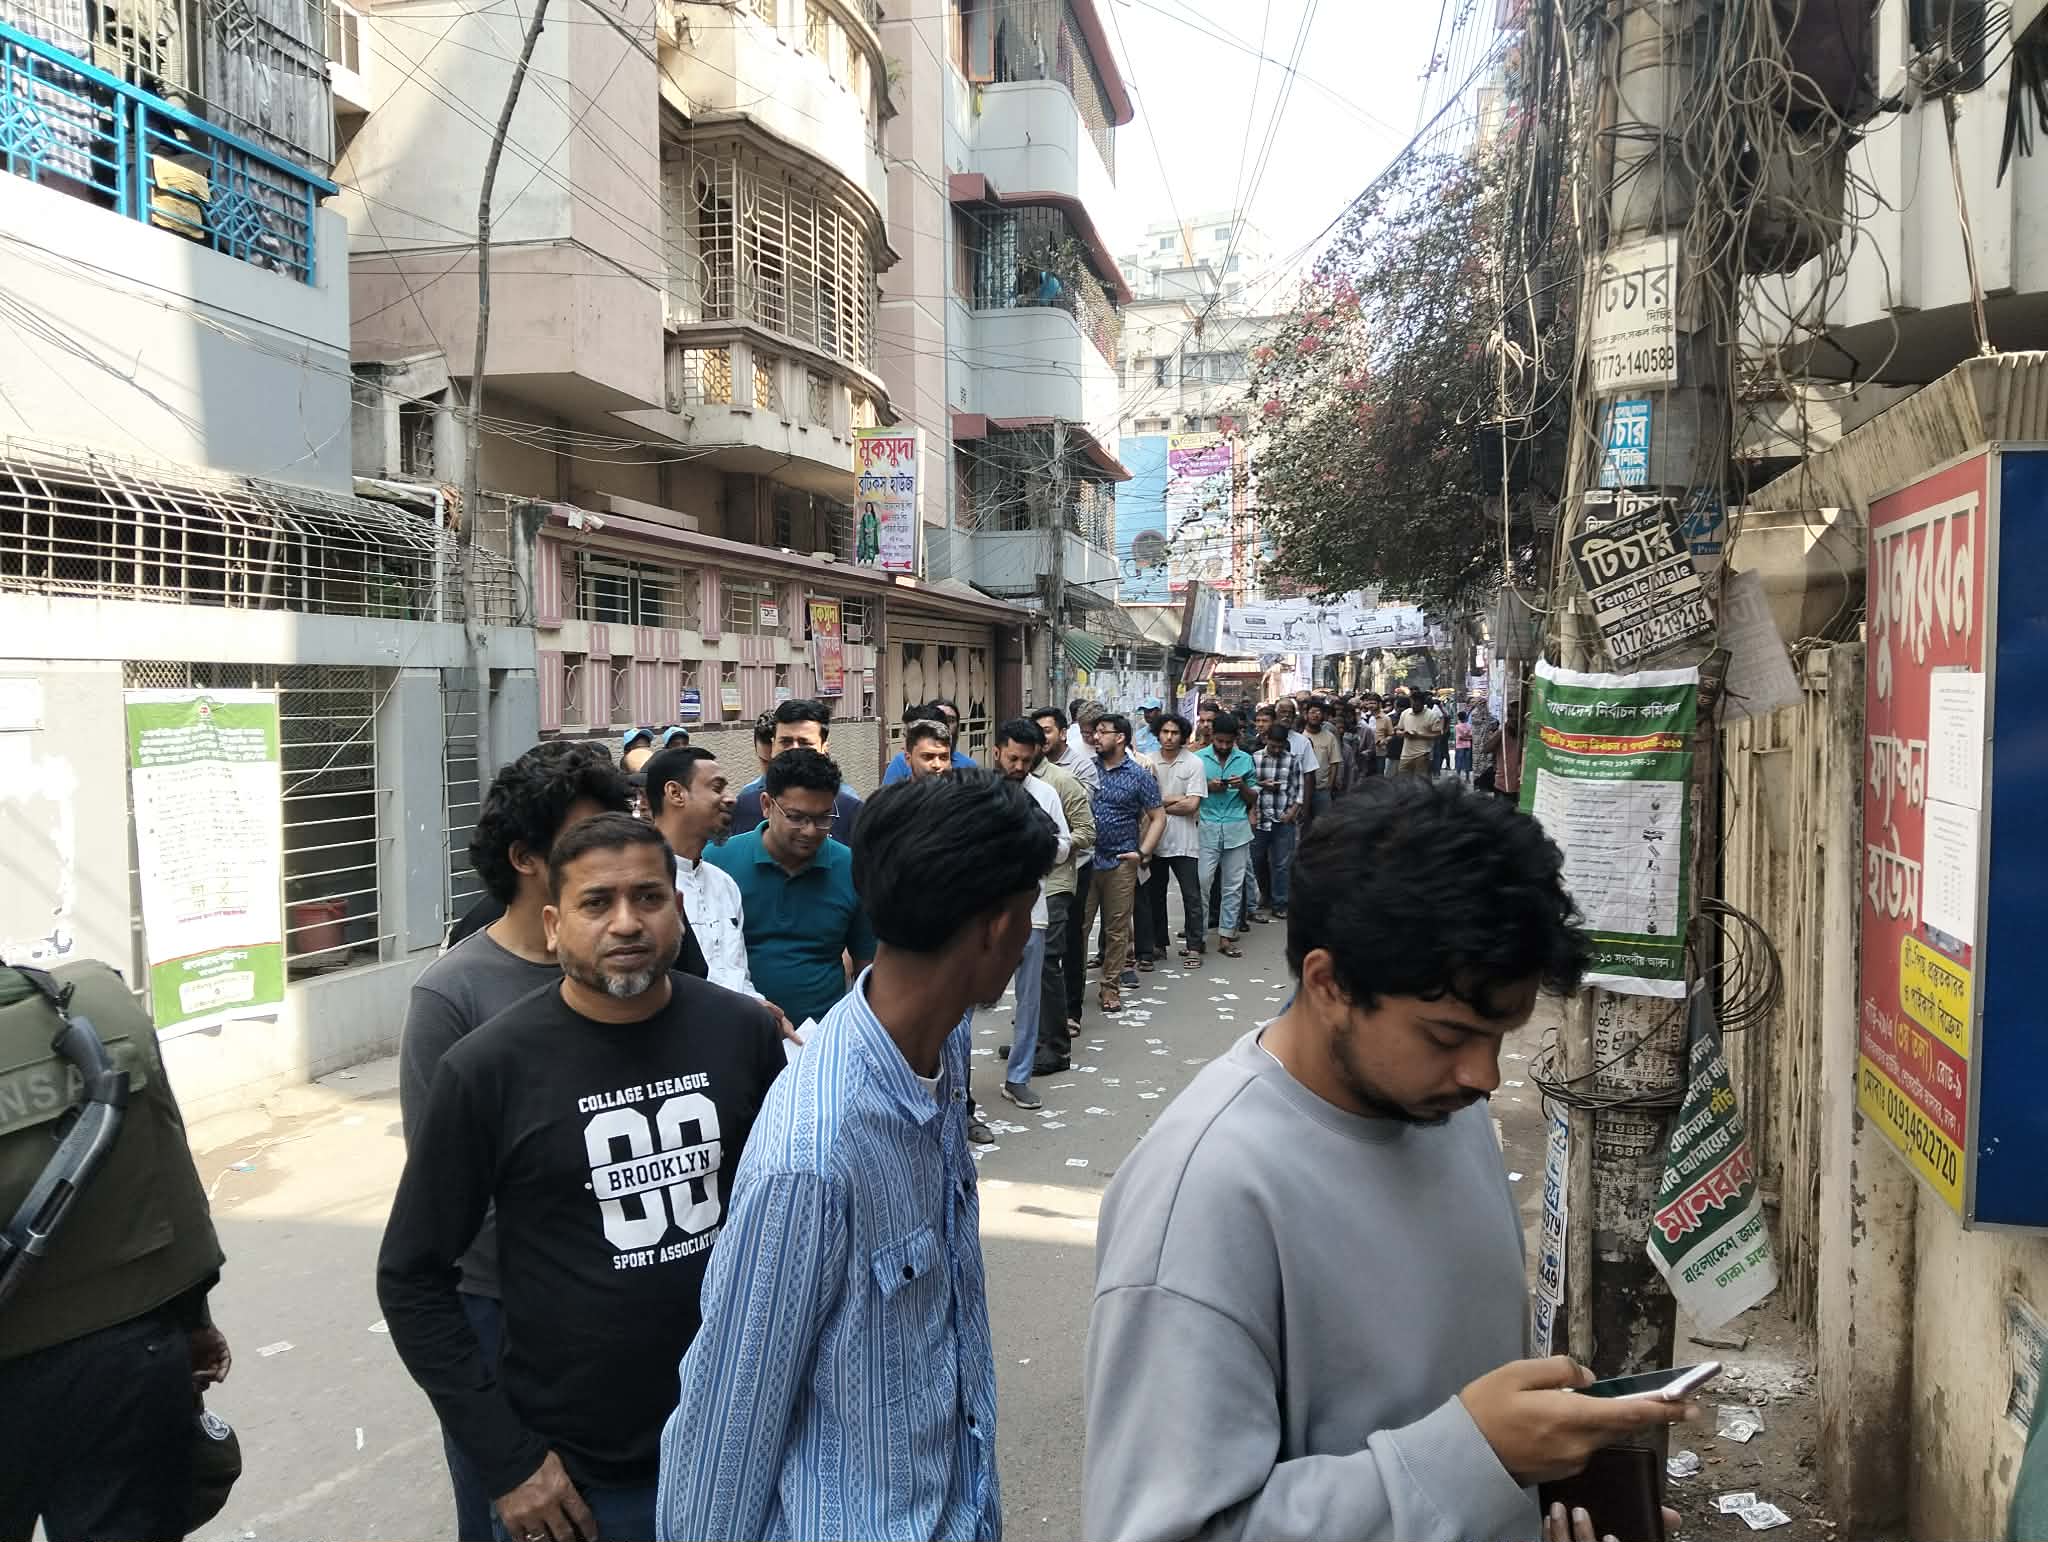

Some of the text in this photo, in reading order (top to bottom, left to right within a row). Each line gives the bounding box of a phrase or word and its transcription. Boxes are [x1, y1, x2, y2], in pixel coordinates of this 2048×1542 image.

[1870, 733, 1926, 830] ফ্যাশন
[578, 1072, 710, 1113] COLLAGE LEEAGUE
[1887, 1086, 1956, 1189] 01914622720
[608, 1150, 710, 1191] BROOKLYN
[613, 1250, 654, 1270] SPORT
